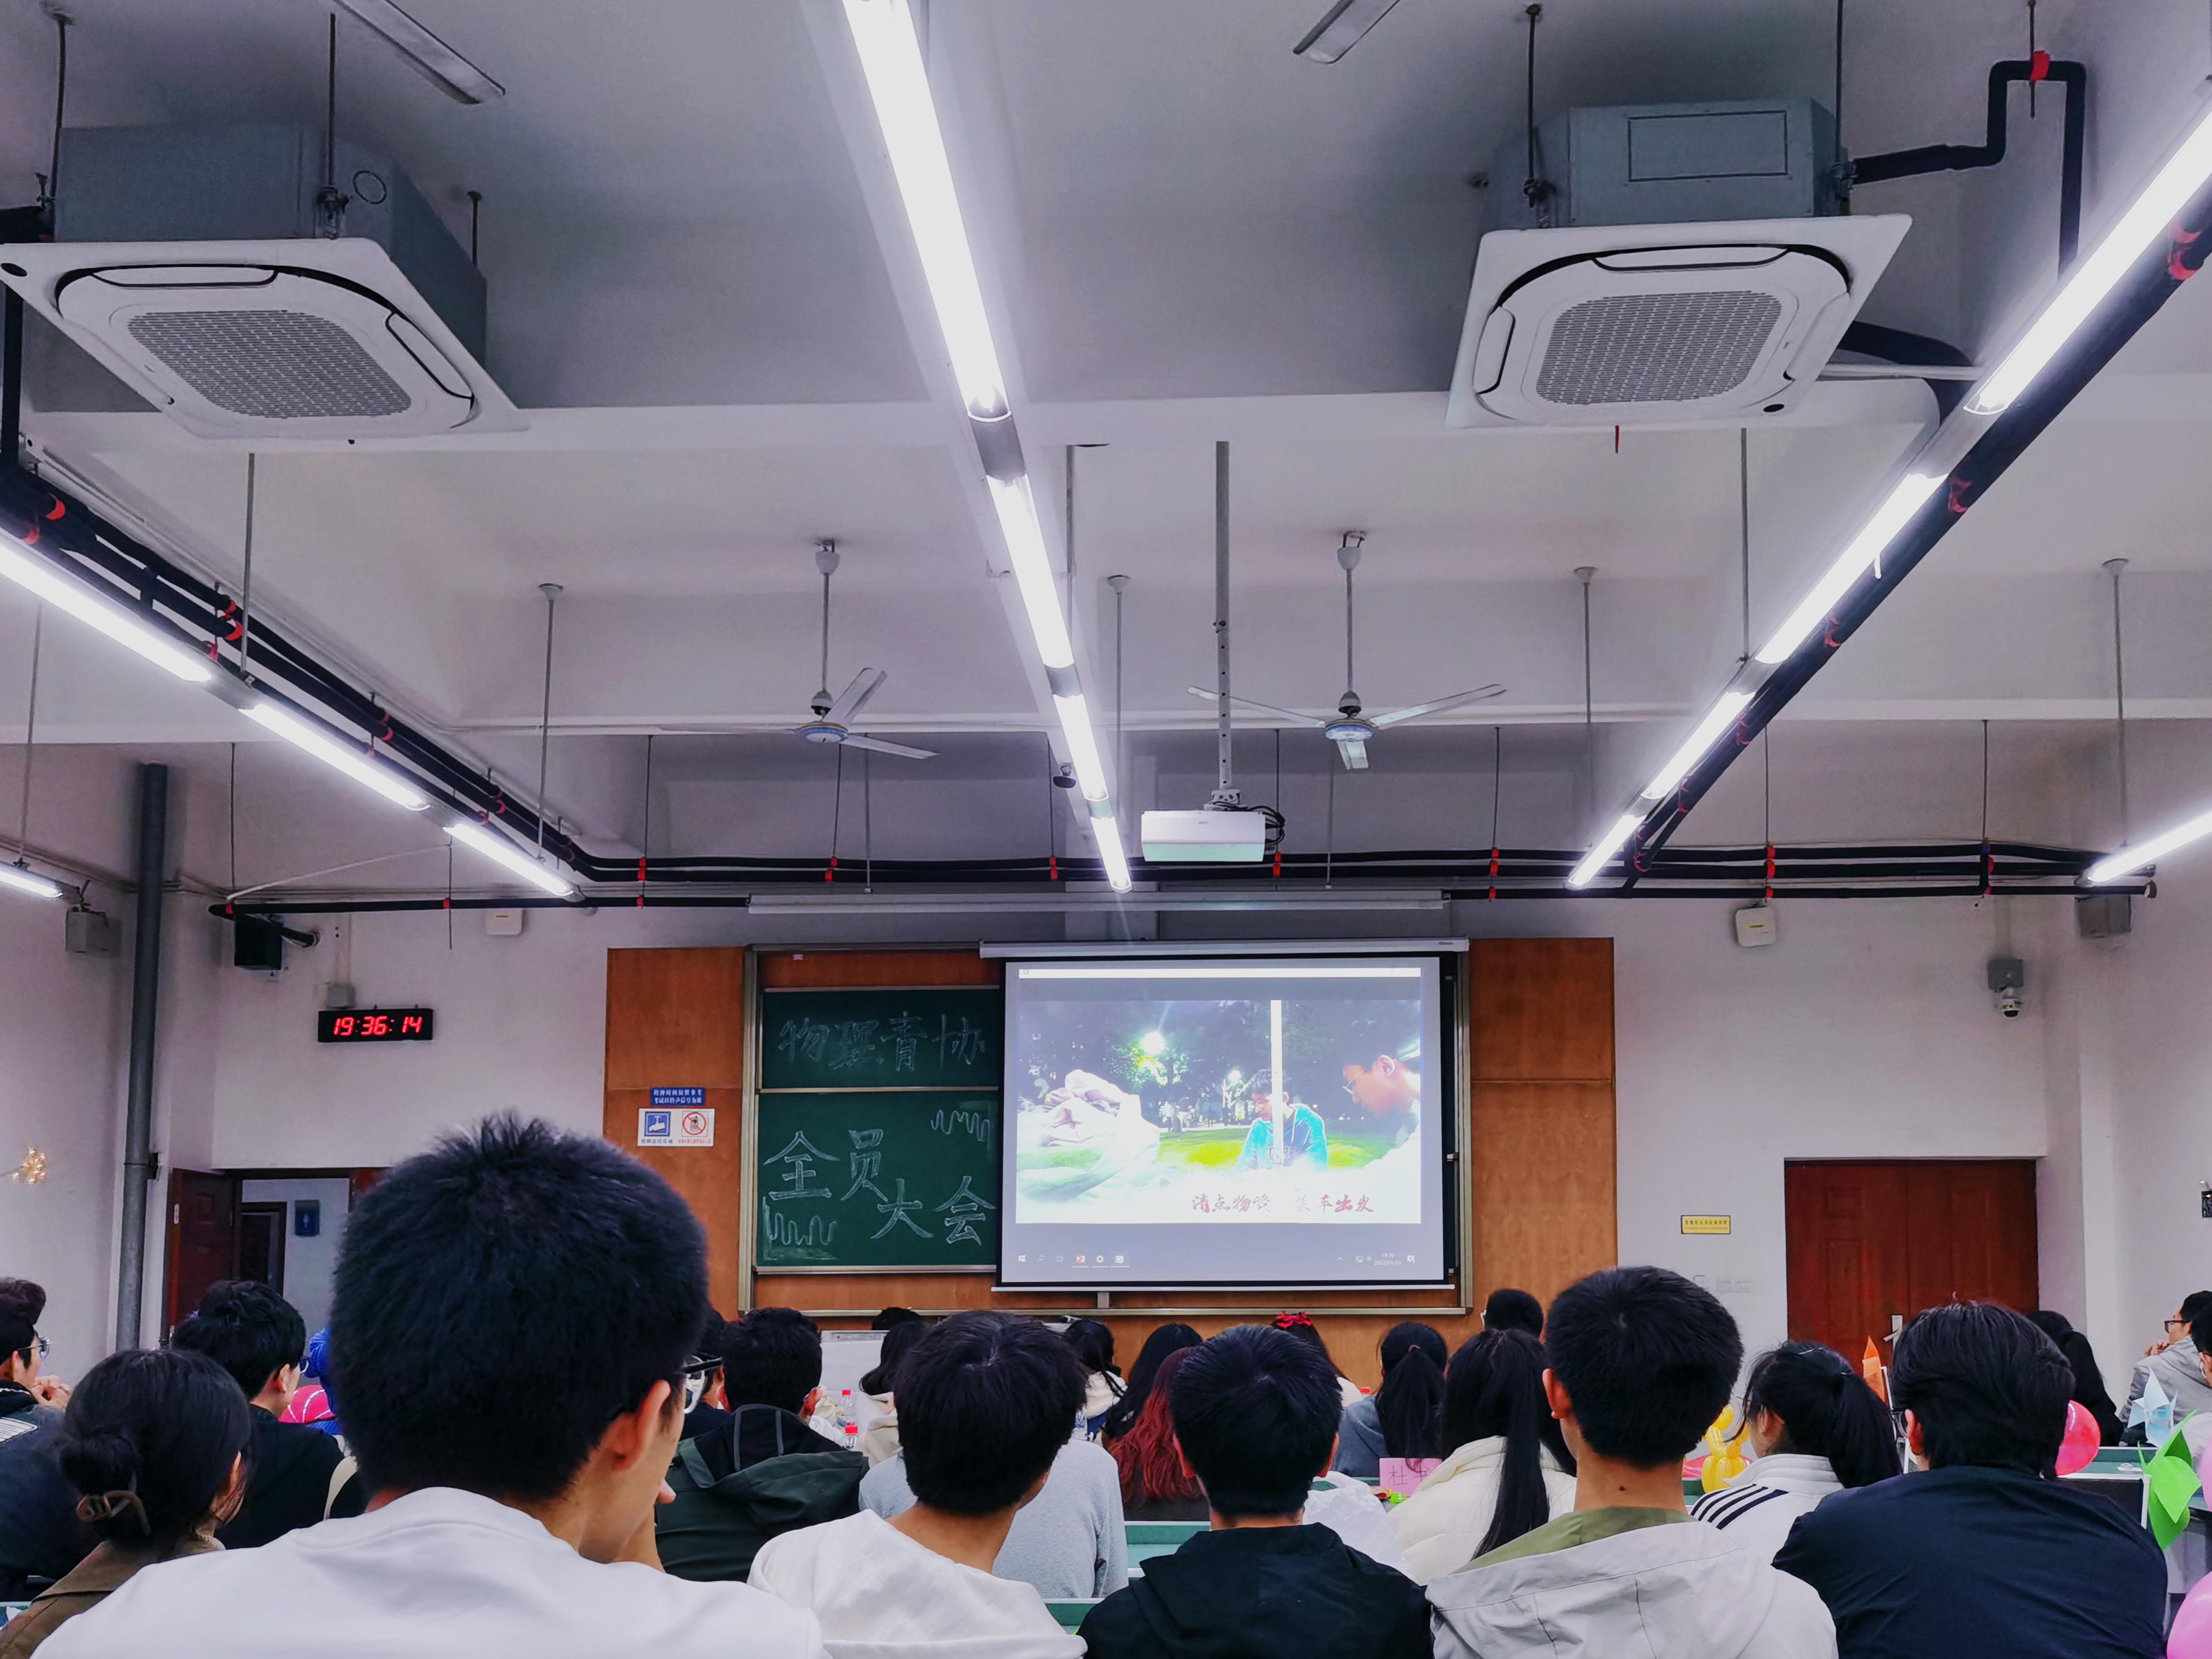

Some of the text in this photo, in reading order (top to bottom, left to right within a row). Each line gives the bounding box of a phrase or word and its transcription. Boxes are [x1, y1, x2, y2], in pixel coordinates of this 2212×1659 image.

[333, 1015, 423, 1036] 19:36:14
[1192, 1194, 1271, 1213] 清点物资
